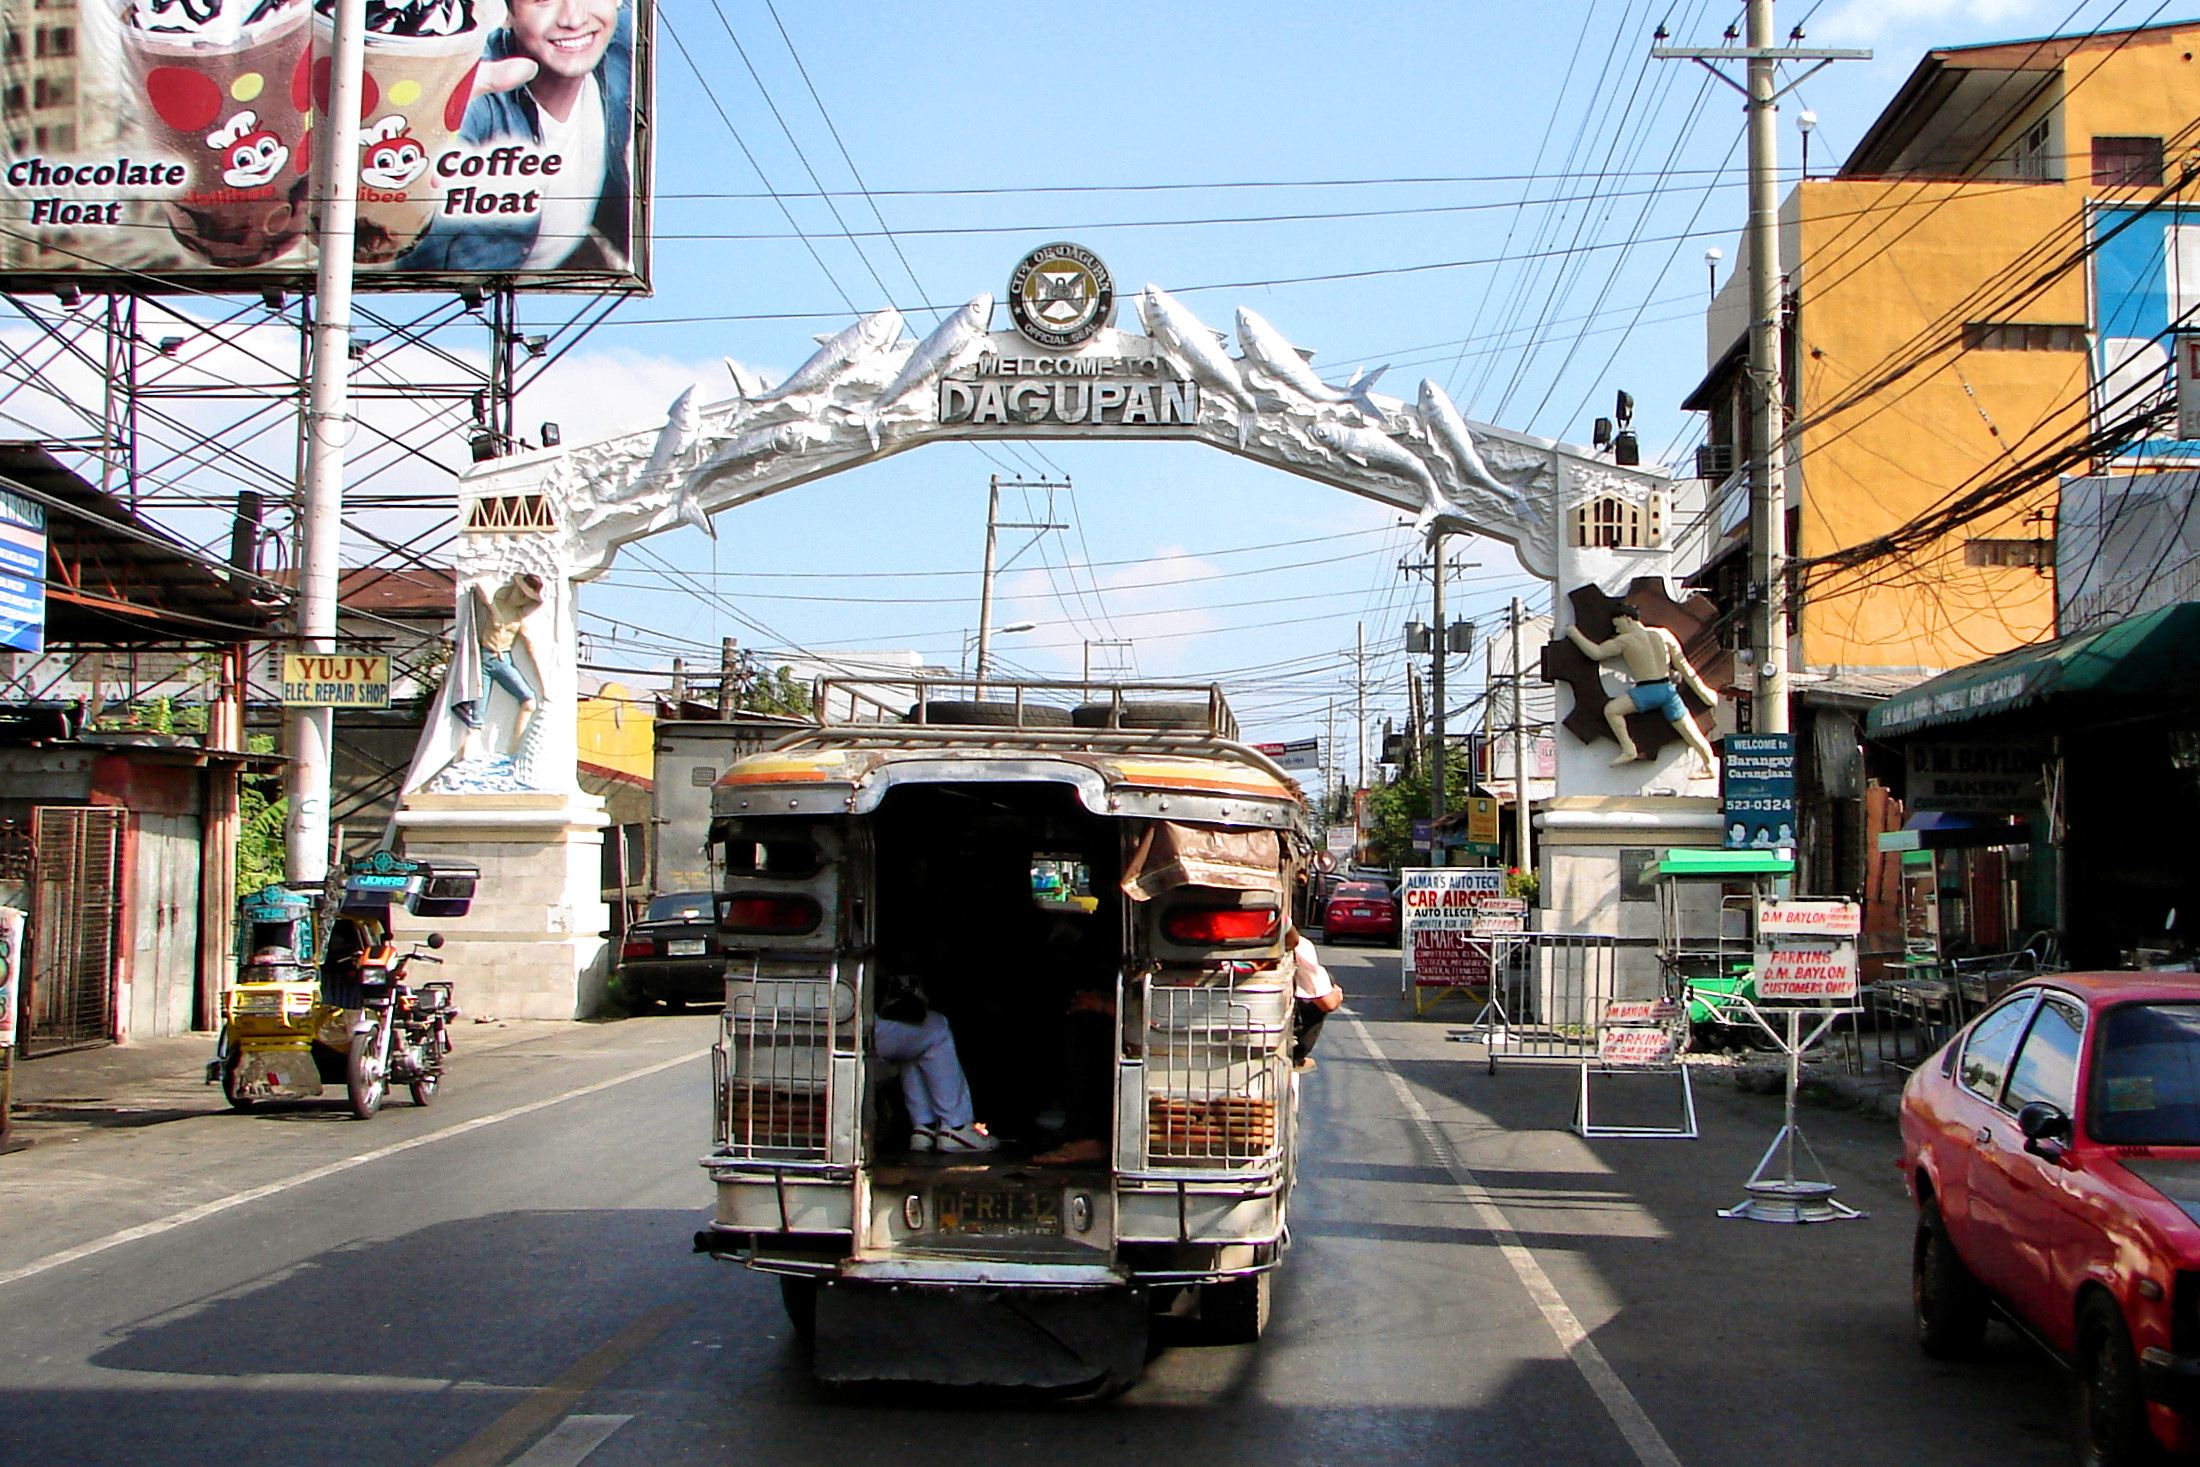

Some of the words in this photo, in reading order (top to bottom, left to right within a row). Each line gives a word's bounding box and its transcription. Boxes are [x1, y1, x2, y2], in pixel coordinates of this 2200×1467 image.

[436, 145, 563, 178] Coffee
[6, 157, 186, 187] Chocolate
[357, 185, 408, 203] ibee
[443, 186, 540, 215] Float
[30, 197, 123, 225] Float
[1011, 258, 1034, 294] CITY
[1056, 245, 1112, 293] DAGUPAN
[1024, 322, 1068, 345] OFFICIAL
[1071, 321, 1100, 342] SEAL
[979, 355, 1114, 377] WELCOME
[939, 379, 1198, 426] DAGUPAN
[296, 657, 379, 681] YUJY
[284, 682, 313, 702] ELEC.
[314, 682, 355, 702] REPAIR
[358, 683, 387, 703] SHOP
[1733, 739, 1778, 751] WELCOME
[1778, 739, 1788, 750] to
[1726, 754, 1794, 768] Barangay
[1727, 768, 1793, 780] Caranglaan
[1934, 780, 2021, 795] BAKERY
[1726, 798, 1792, 811] 523-0324
[359, 874, 408, 887] JONAS
[1406, 873, 1446, 889] ALMAR'S
[1448, 876, 1474, 889] AUTO
[1475, 876, 1500, 889] TECH
[1406, 890, 1438, 908] CAR
[1414, 908, 1441, 917] AUTO
[1785, 911, 1827, 924] BAYLON
[1770, 949, 1833, 965] PARKING
[1794, 965, 1847, 980] BAYLON
[1762, 982, 1825, 995] CUSTOMERS
[1825, 981, 1854, 993] ONLY
[1605, 1033, 1669, 1046] PARKING
